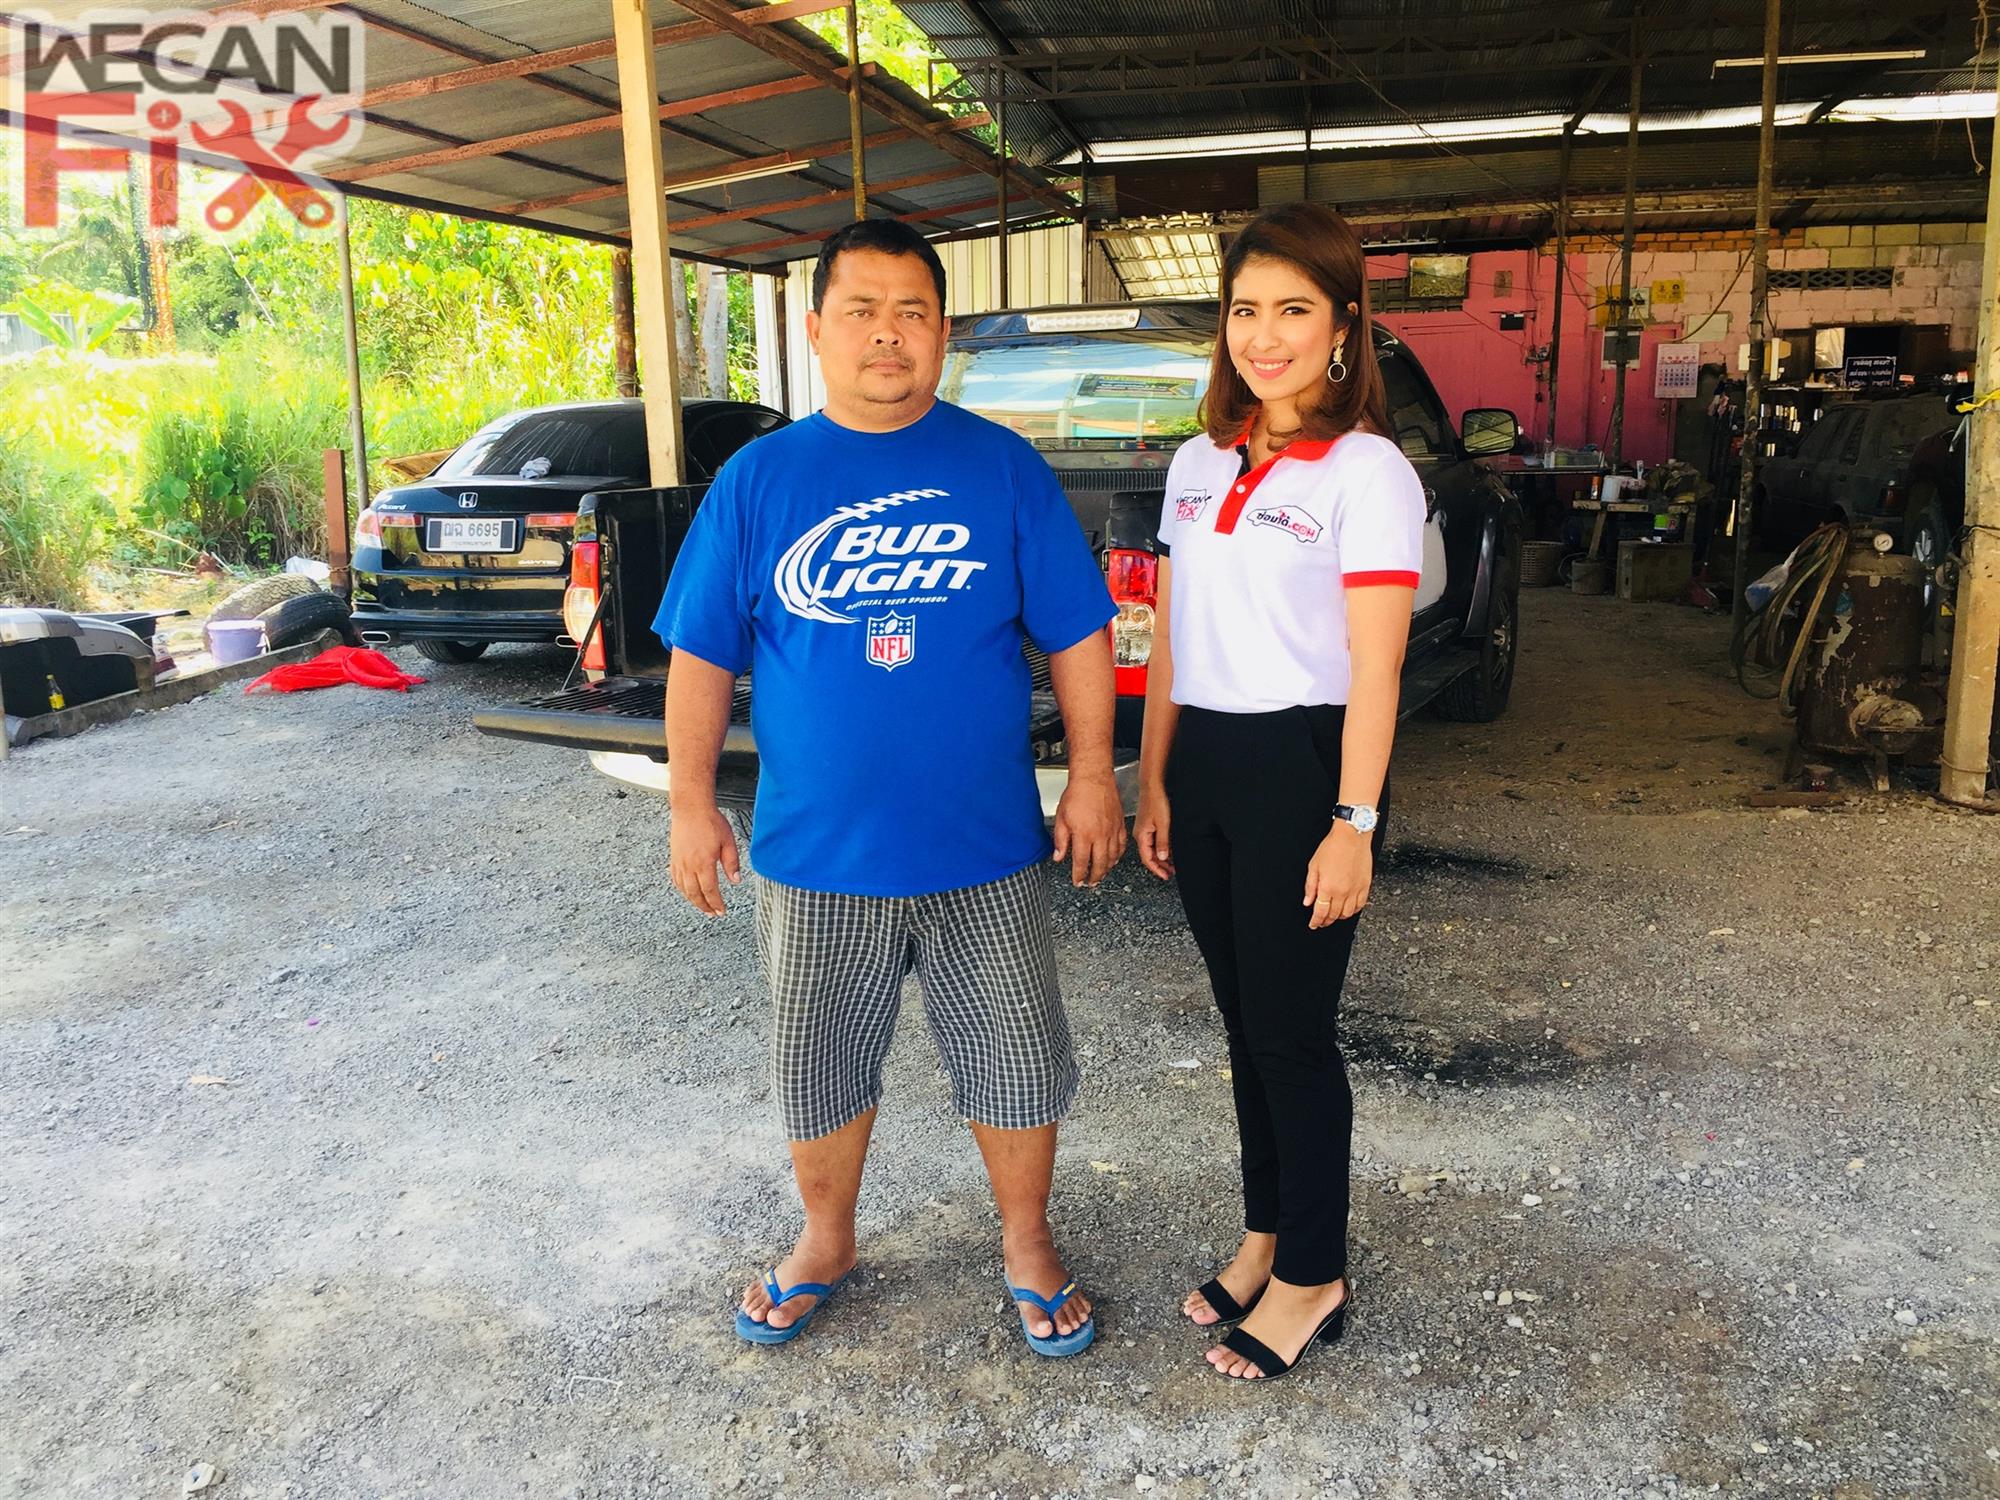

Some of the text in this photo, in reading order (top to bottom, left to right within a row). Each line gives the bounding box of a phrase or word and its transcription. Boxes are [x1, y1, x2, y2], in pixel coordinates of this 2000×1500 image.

[468, 522, 500, 537] 6695
[830, 523, 970, 562] BUD
[807, 559, 988, 609] LIGHT
[845, 598, 883, 611] OFFICIAL
[908, 596, 949, 605] SPONSOR
[872, 636, 909, 662] NFL
